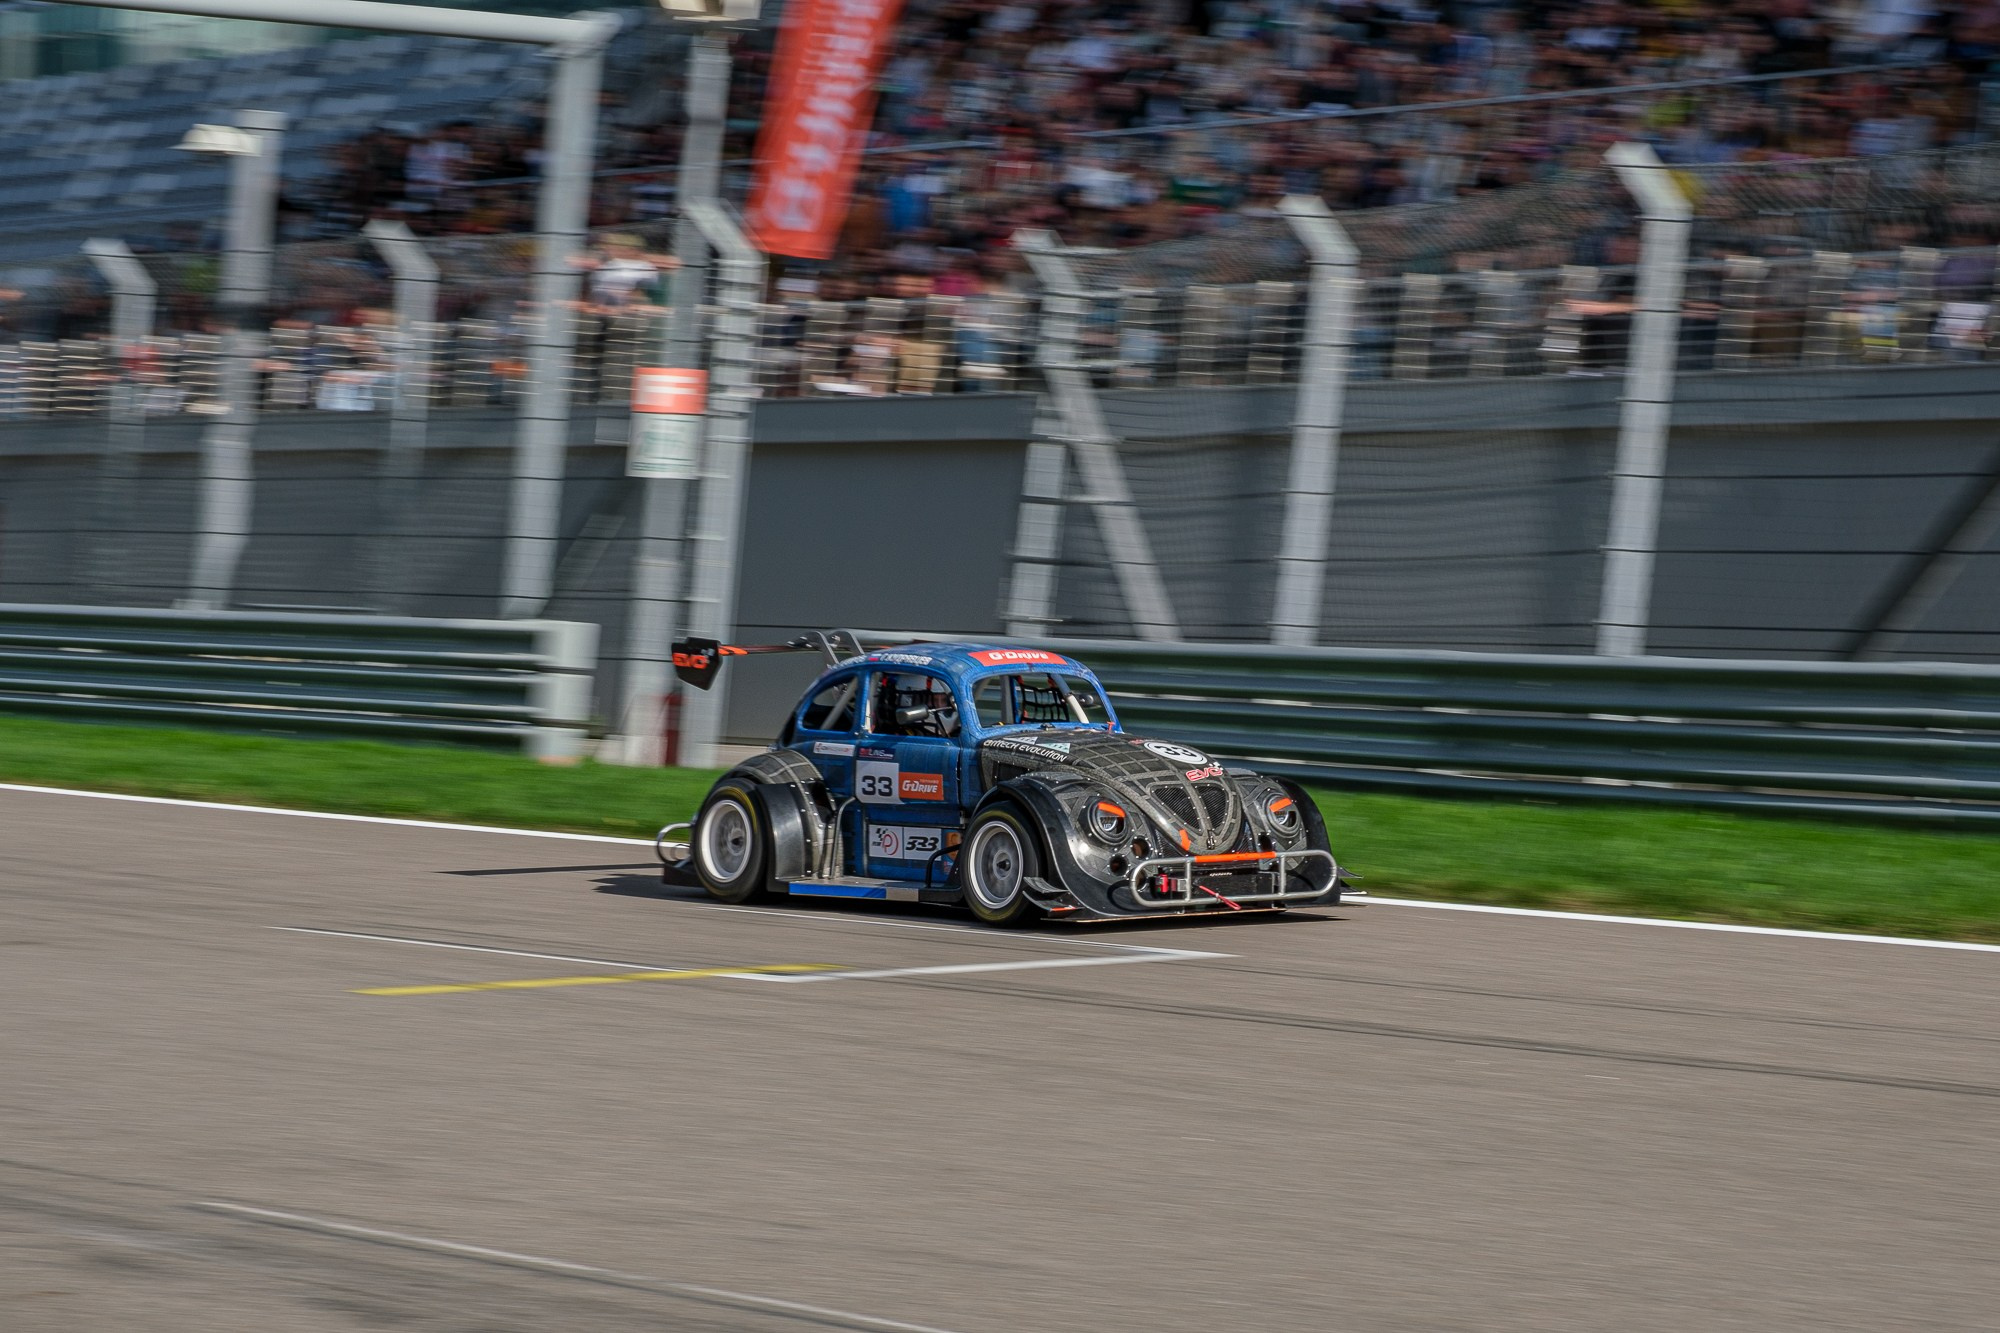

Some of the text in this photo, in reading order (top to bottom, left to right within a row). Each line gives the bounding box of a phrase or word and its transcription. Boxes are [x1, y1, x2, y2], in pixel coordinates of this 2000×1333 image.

[1019, 743, 1068, 763] EVOLUTION
[1154, 745, 1197, 758] 33
[1185, 766, 1223, 782] EVO
[861, 775, 893, 797] 33
